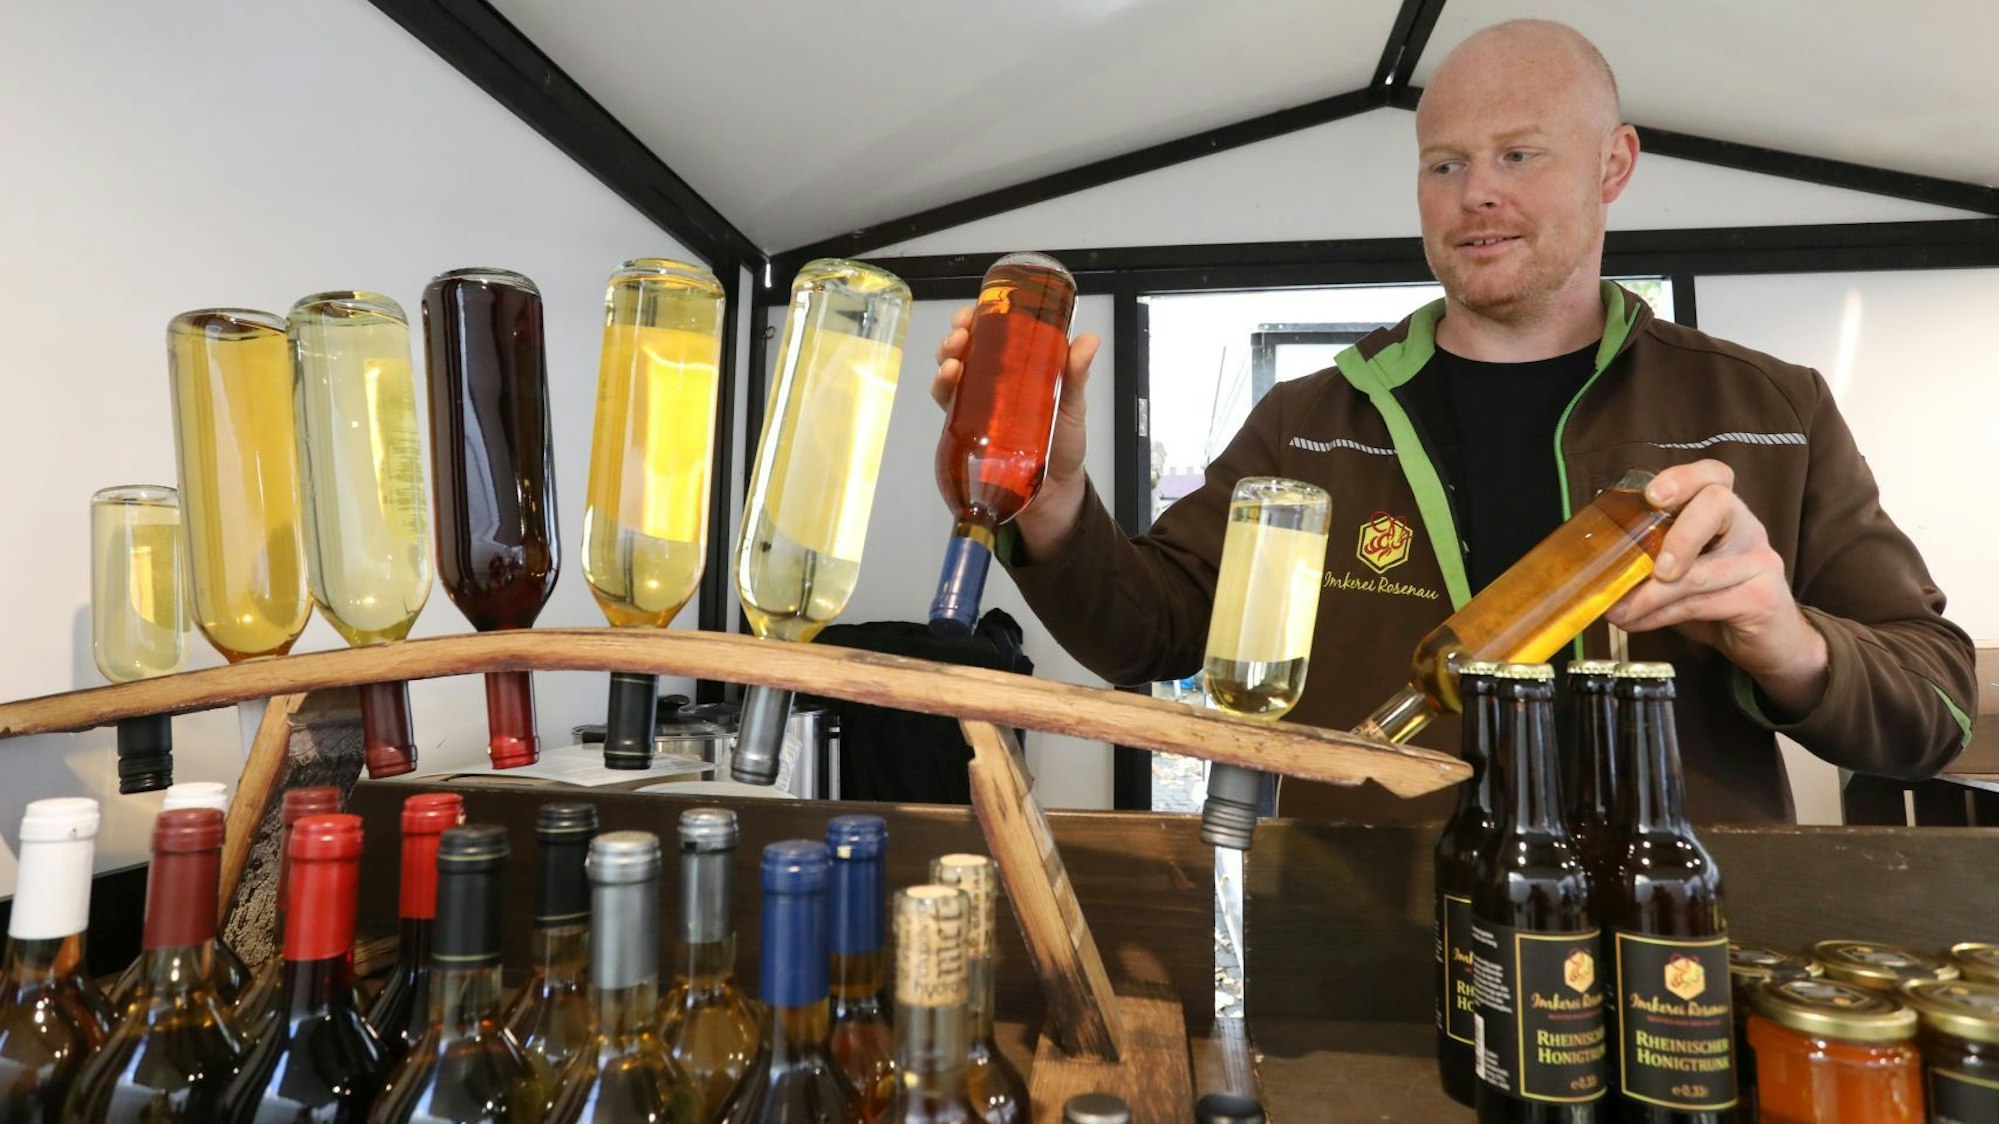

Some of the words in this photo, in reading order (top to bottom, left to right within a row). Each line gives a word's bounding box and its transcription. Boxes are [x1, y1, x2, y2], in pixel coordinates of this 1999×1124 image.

[1323, 571, 1376, 592] Imkerei
[1378, 576, 1439, 600] Rosenau
[1637, 1048, 1731, 1072] HONIGTRUNK
